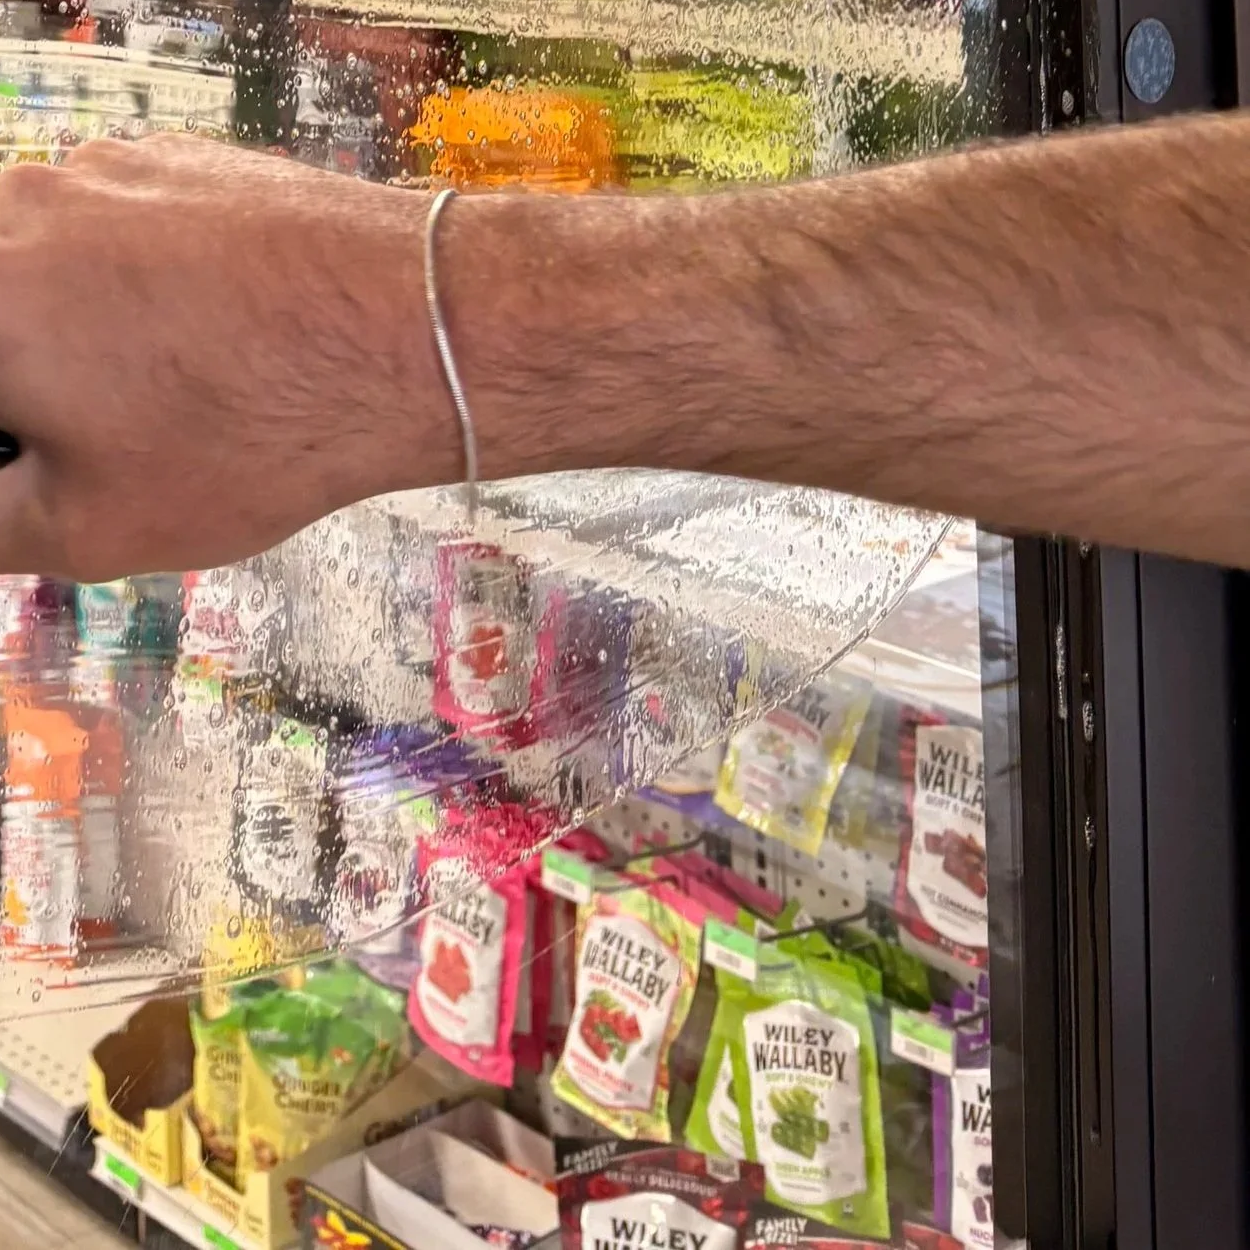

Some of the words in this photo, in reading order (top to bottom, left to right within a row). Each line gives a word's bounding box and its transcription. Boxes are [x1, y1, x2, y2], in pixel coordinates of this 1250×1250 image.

[602, 925, 669, 971] WILEY
[584, 938, 671, 1007] WALLABY
[764, 1023, 834, 1047] WILEY
[753, 1041, 847, 1083] WALLABY
[564, 1141, 617, 1167] FAMILY
[611, 1217, 708, 1250] WILEY
[754, 1217, 807, 1235] FAMILY
